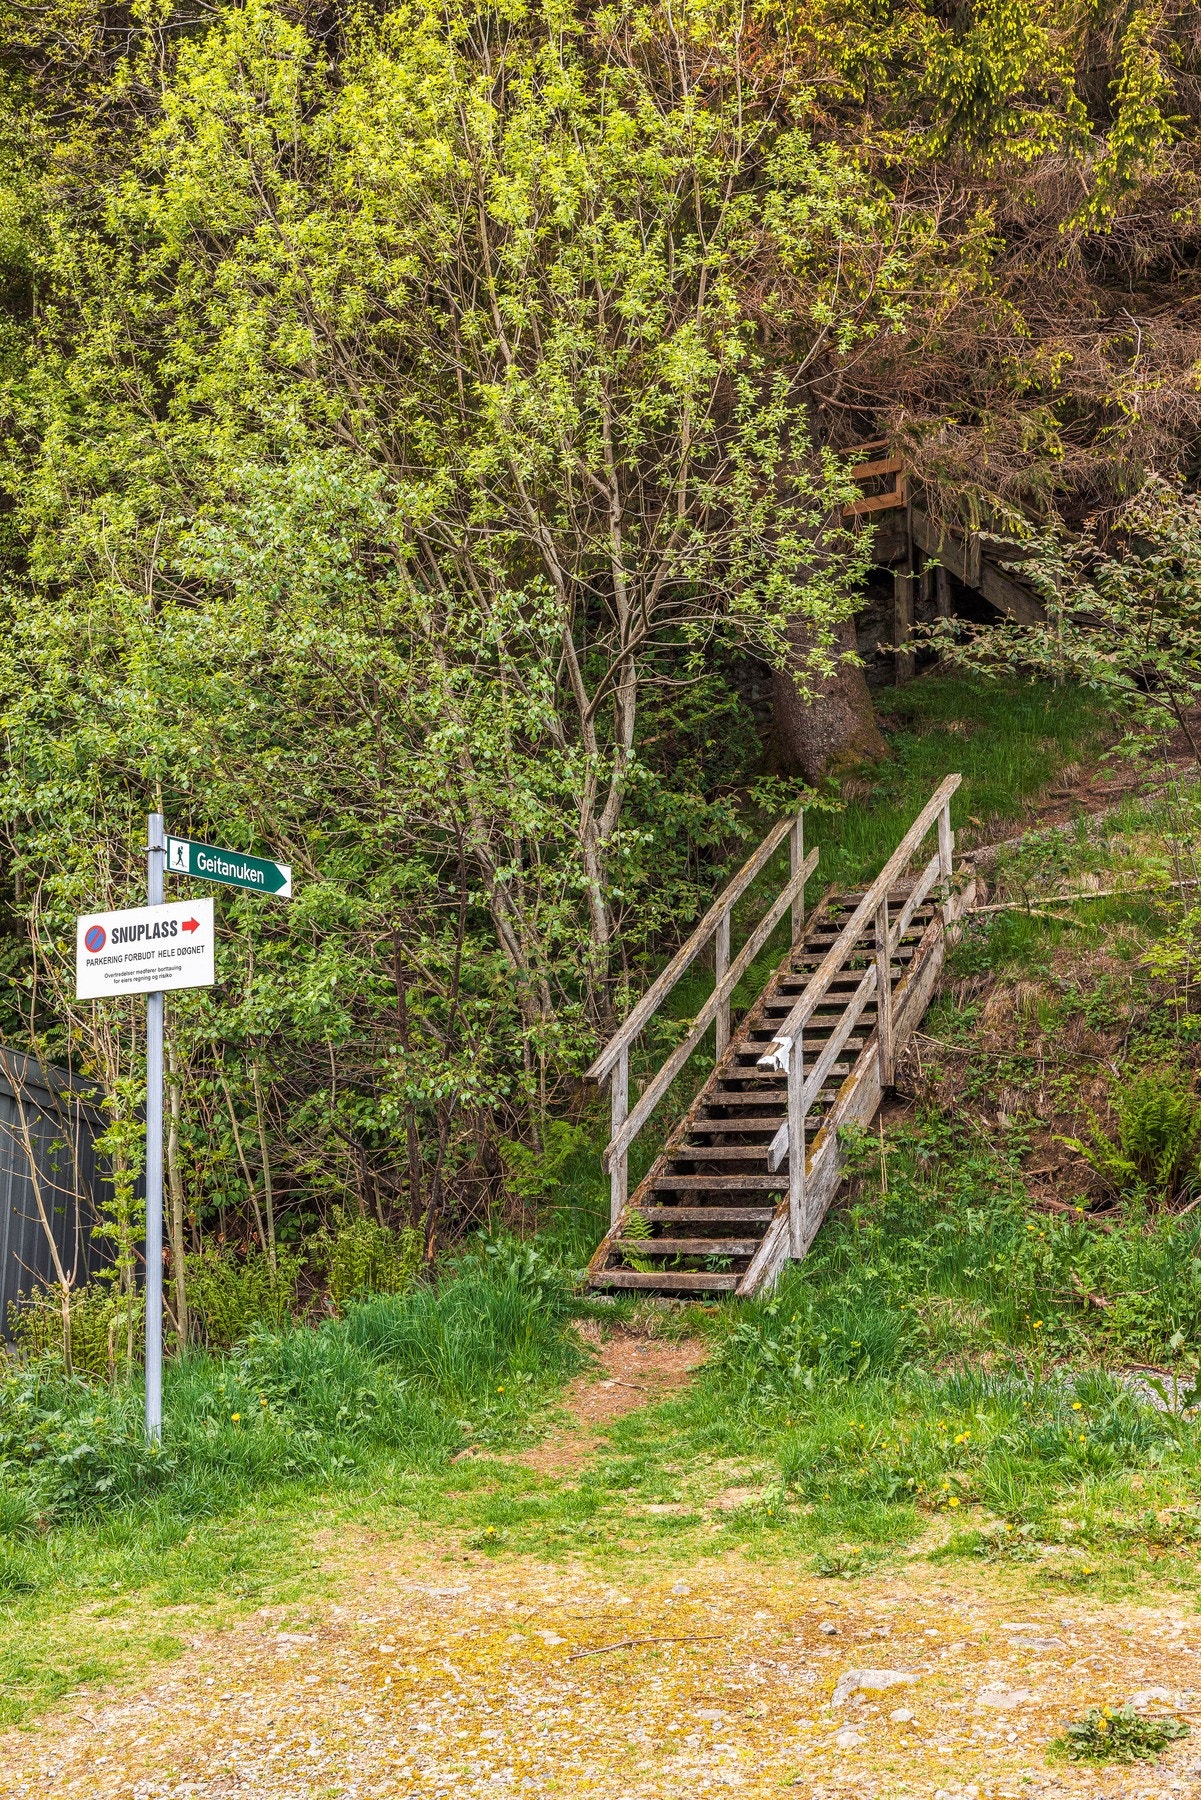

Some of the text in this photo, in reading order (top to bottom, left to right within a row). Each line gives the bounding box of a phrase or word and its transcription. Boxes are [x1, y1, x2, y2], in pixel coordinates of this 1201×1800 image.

[197, 852, 264, 884] Geitanuken
[111, 920, 178, 944] SNUPLASS
[86, 945, 205, 967] PARKERING FORBUDT HELE DØGNET
